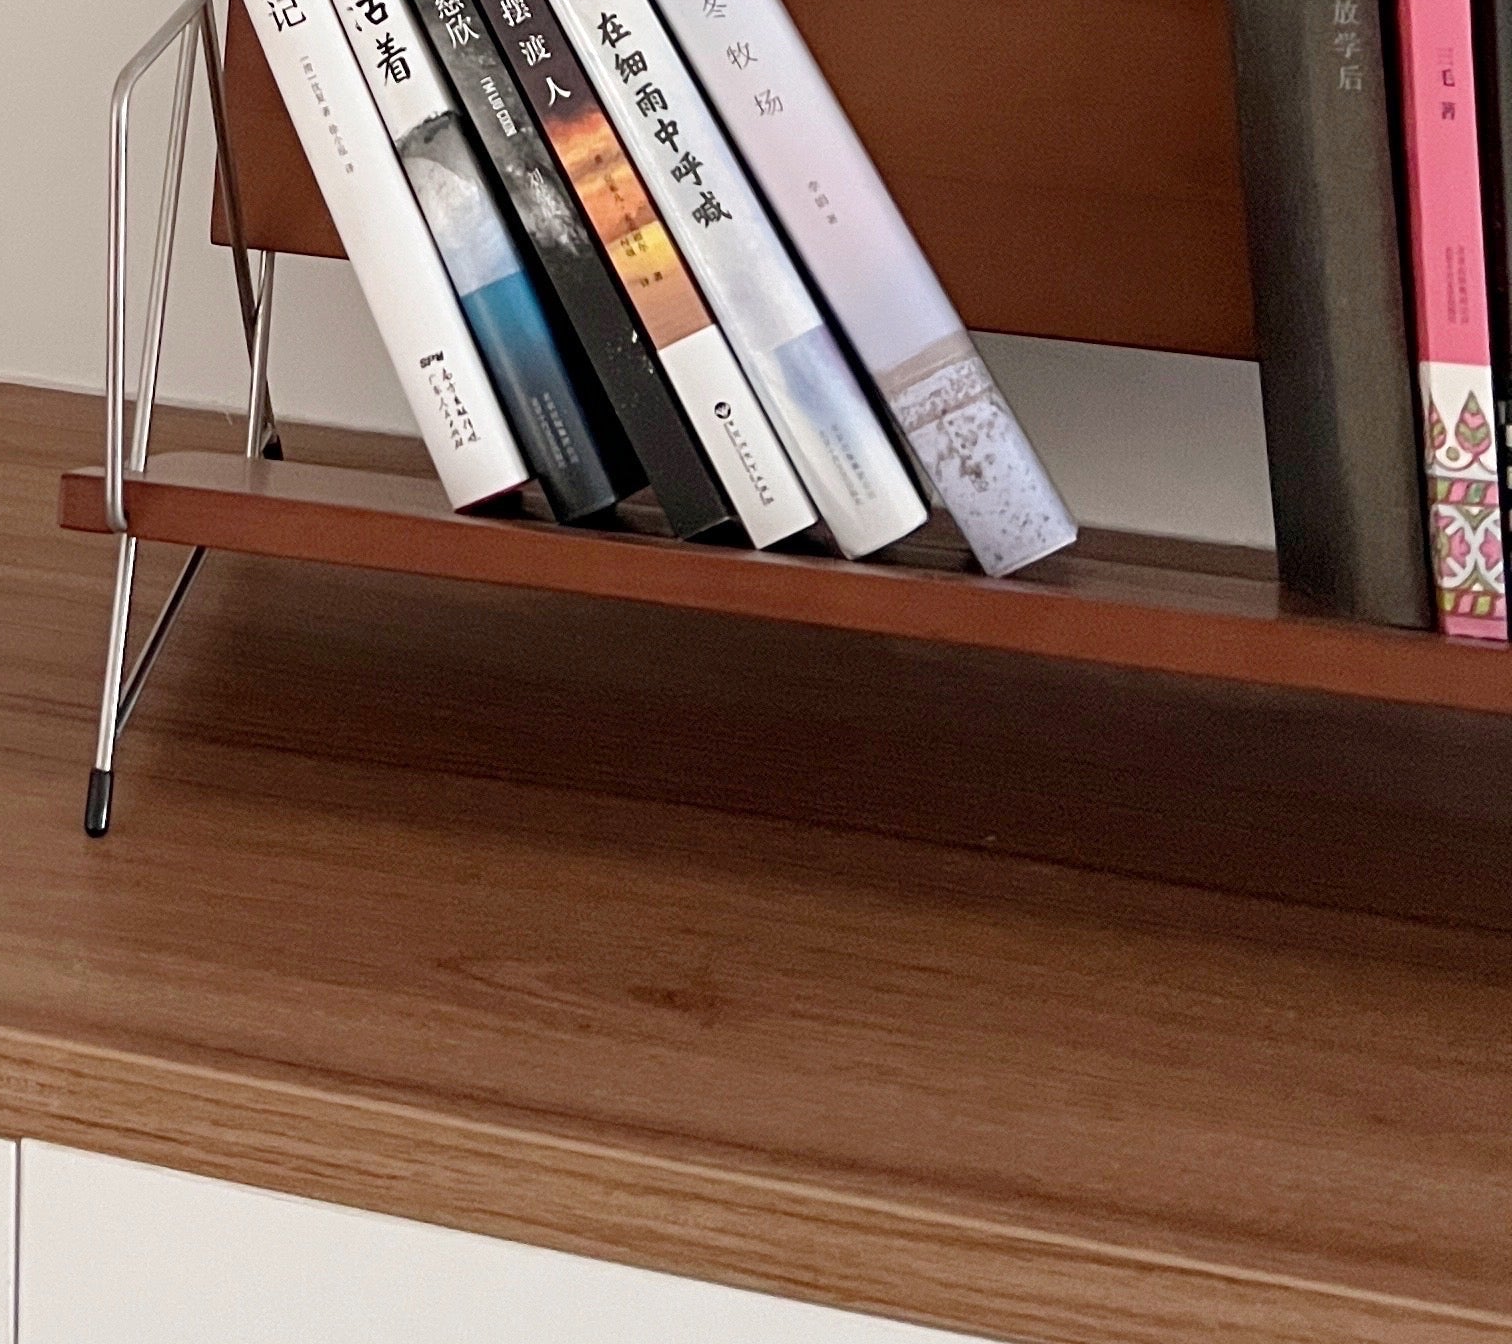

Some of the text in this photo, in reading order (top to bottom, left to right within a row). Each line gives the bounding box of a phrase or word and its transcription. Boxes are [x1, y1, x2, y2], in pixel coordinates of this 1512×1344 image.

[597, 11, 733, 229] 在细雨中呼喊
